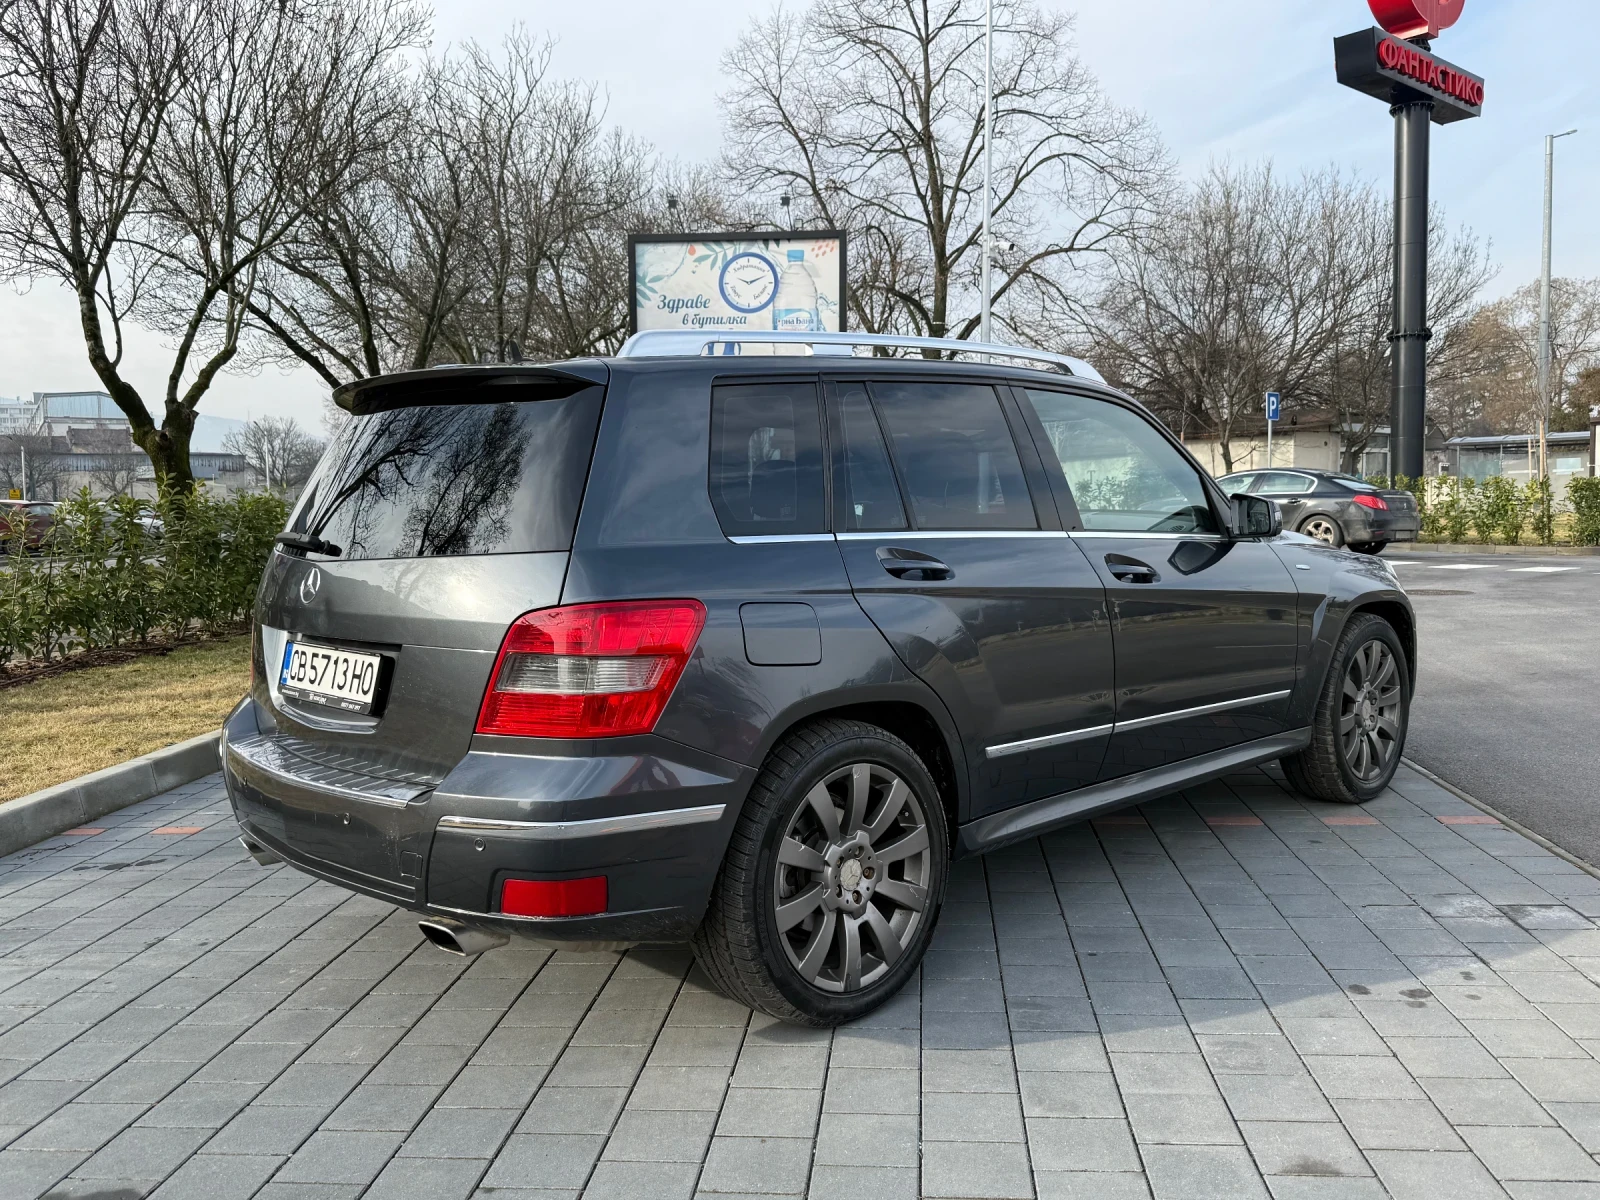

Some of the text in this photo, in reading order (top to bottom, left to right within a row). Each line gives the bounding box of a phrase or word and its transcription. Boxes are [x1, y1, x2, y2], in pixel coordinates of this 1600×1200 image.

[1379, 37, 1484, 106] ФАНТАСТИКО
[657, 293, 711, 314] Здраве
[682, 313, 748, 329] в бутилка
[1269, 396, 1277, 417] P
